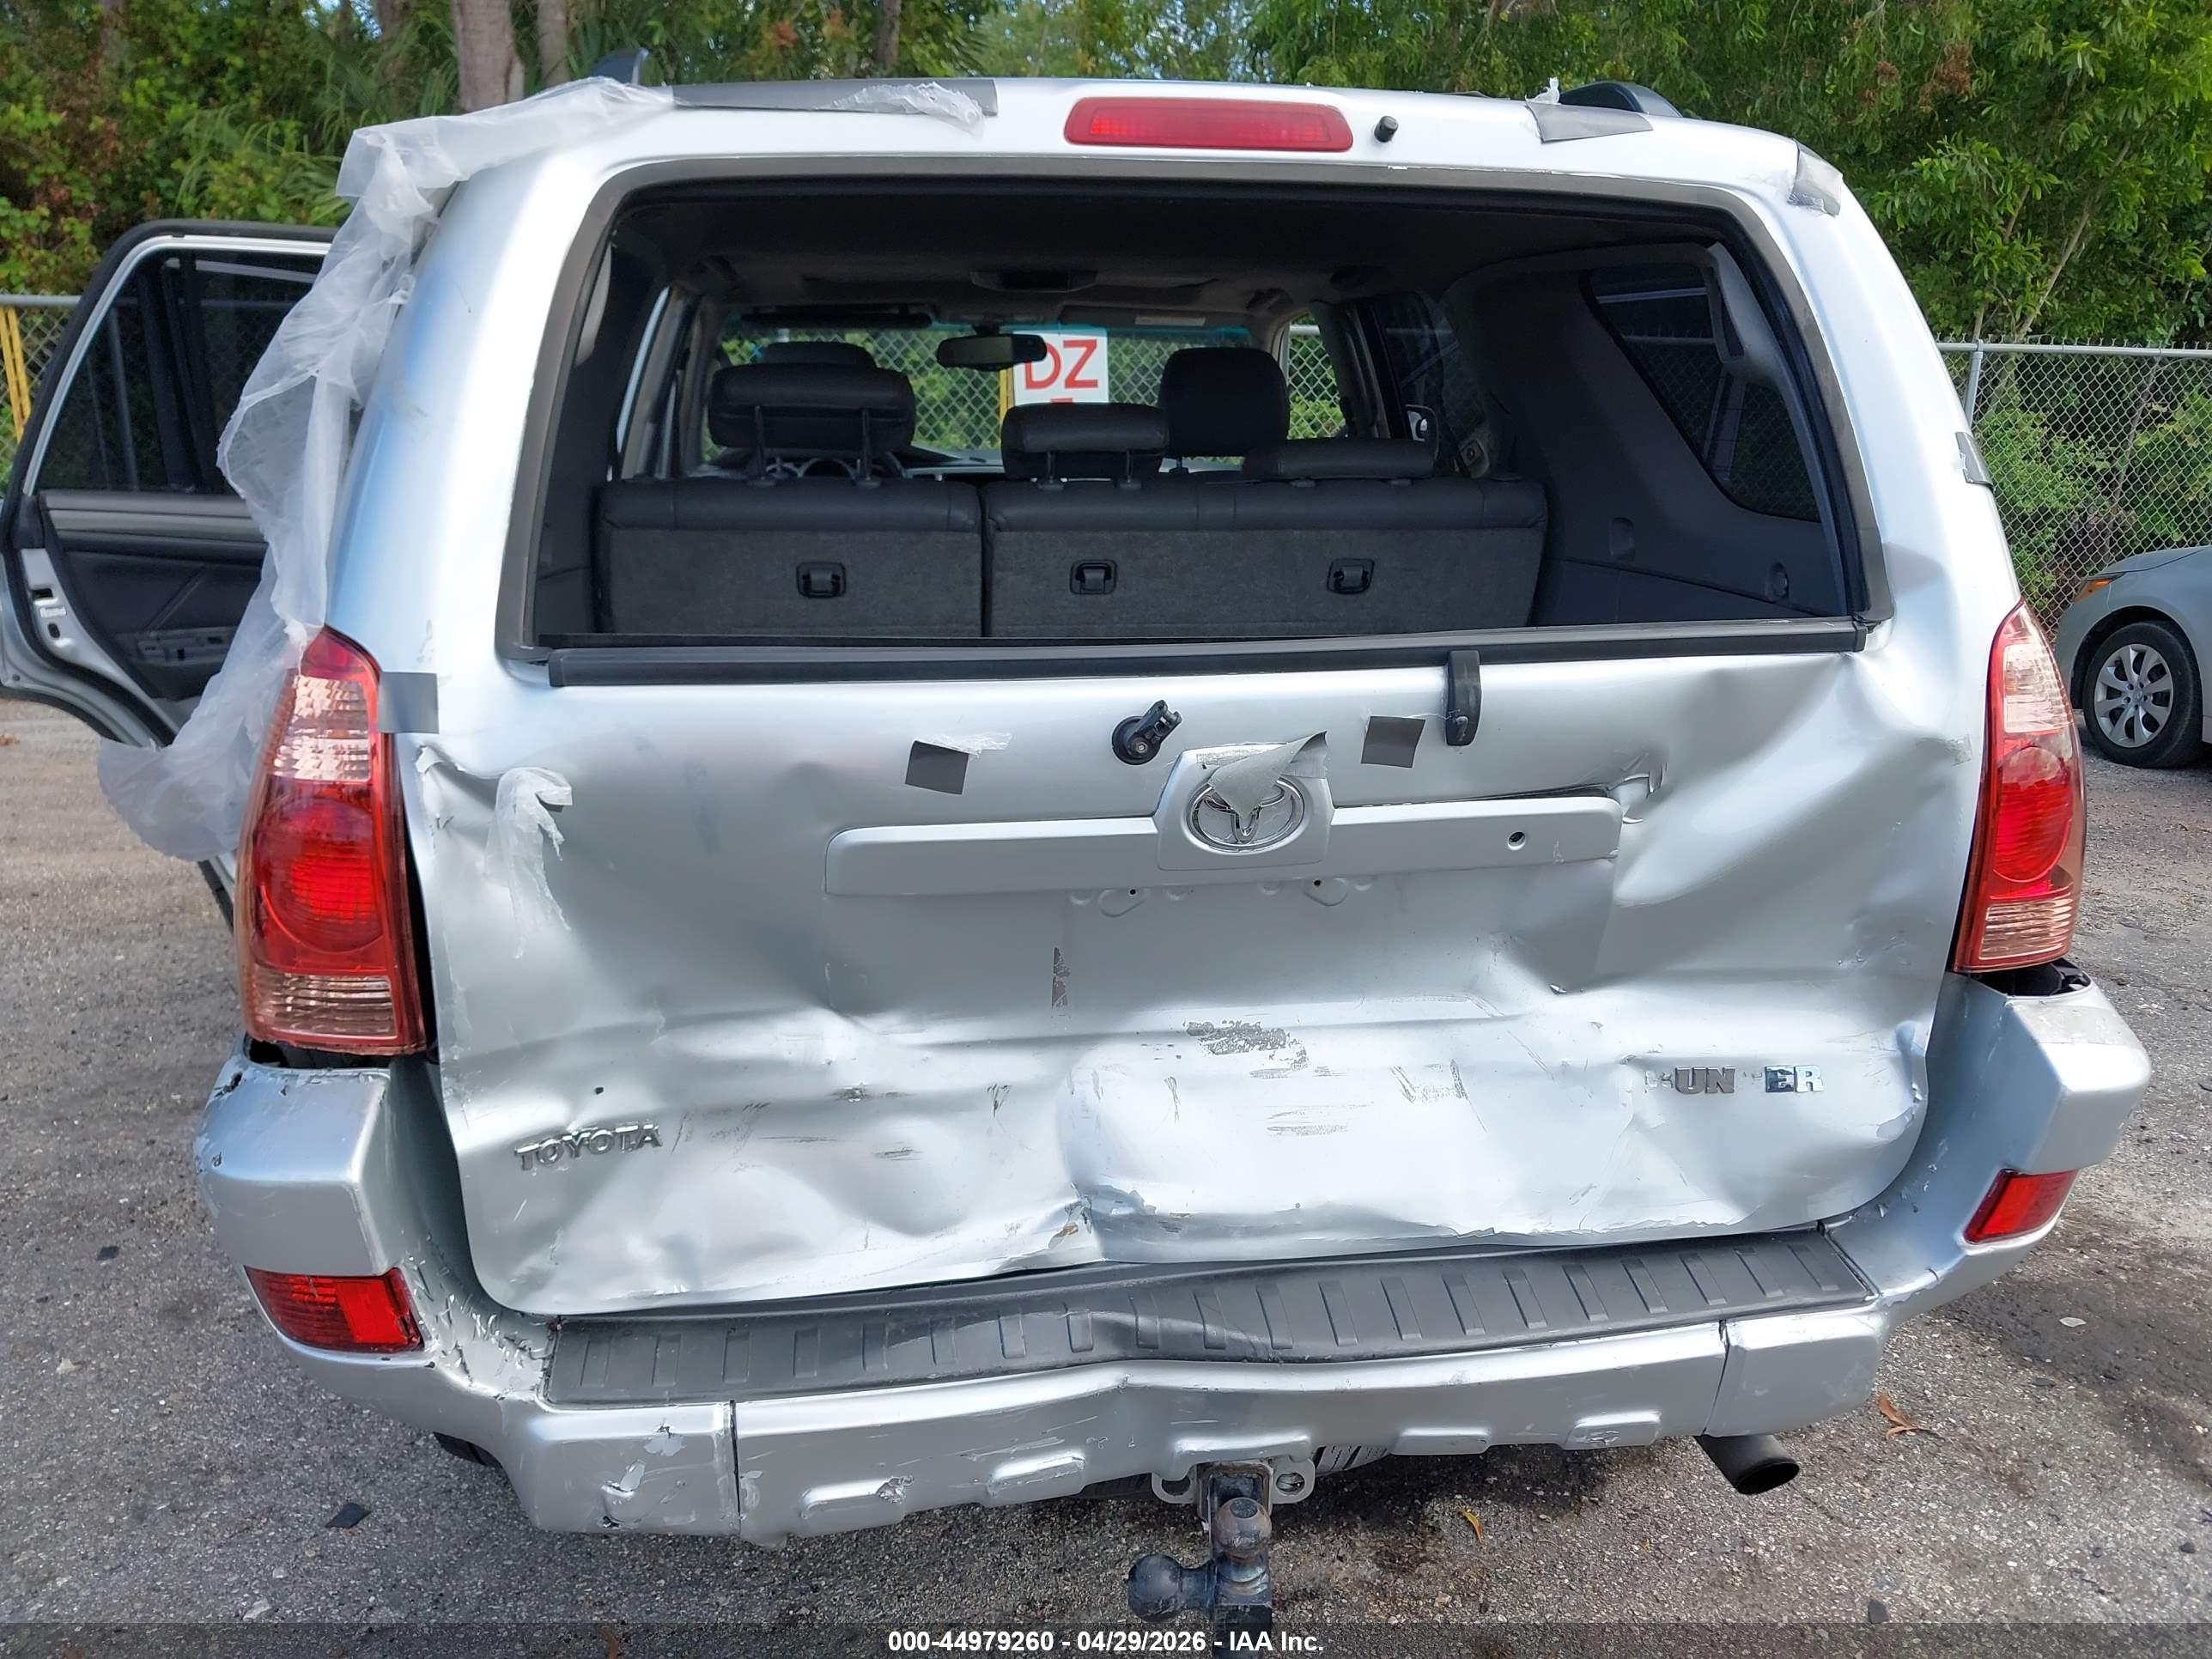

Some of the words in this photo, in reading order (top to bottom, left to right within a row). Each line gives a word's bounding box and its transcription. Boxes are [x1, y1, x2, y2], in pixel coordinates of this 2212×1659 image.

[1024, 339, 1098, 390] DZ
[1644, 1065, 1825, 1095] UNER
[515, 1123, 663, 1170] TOYOTA
